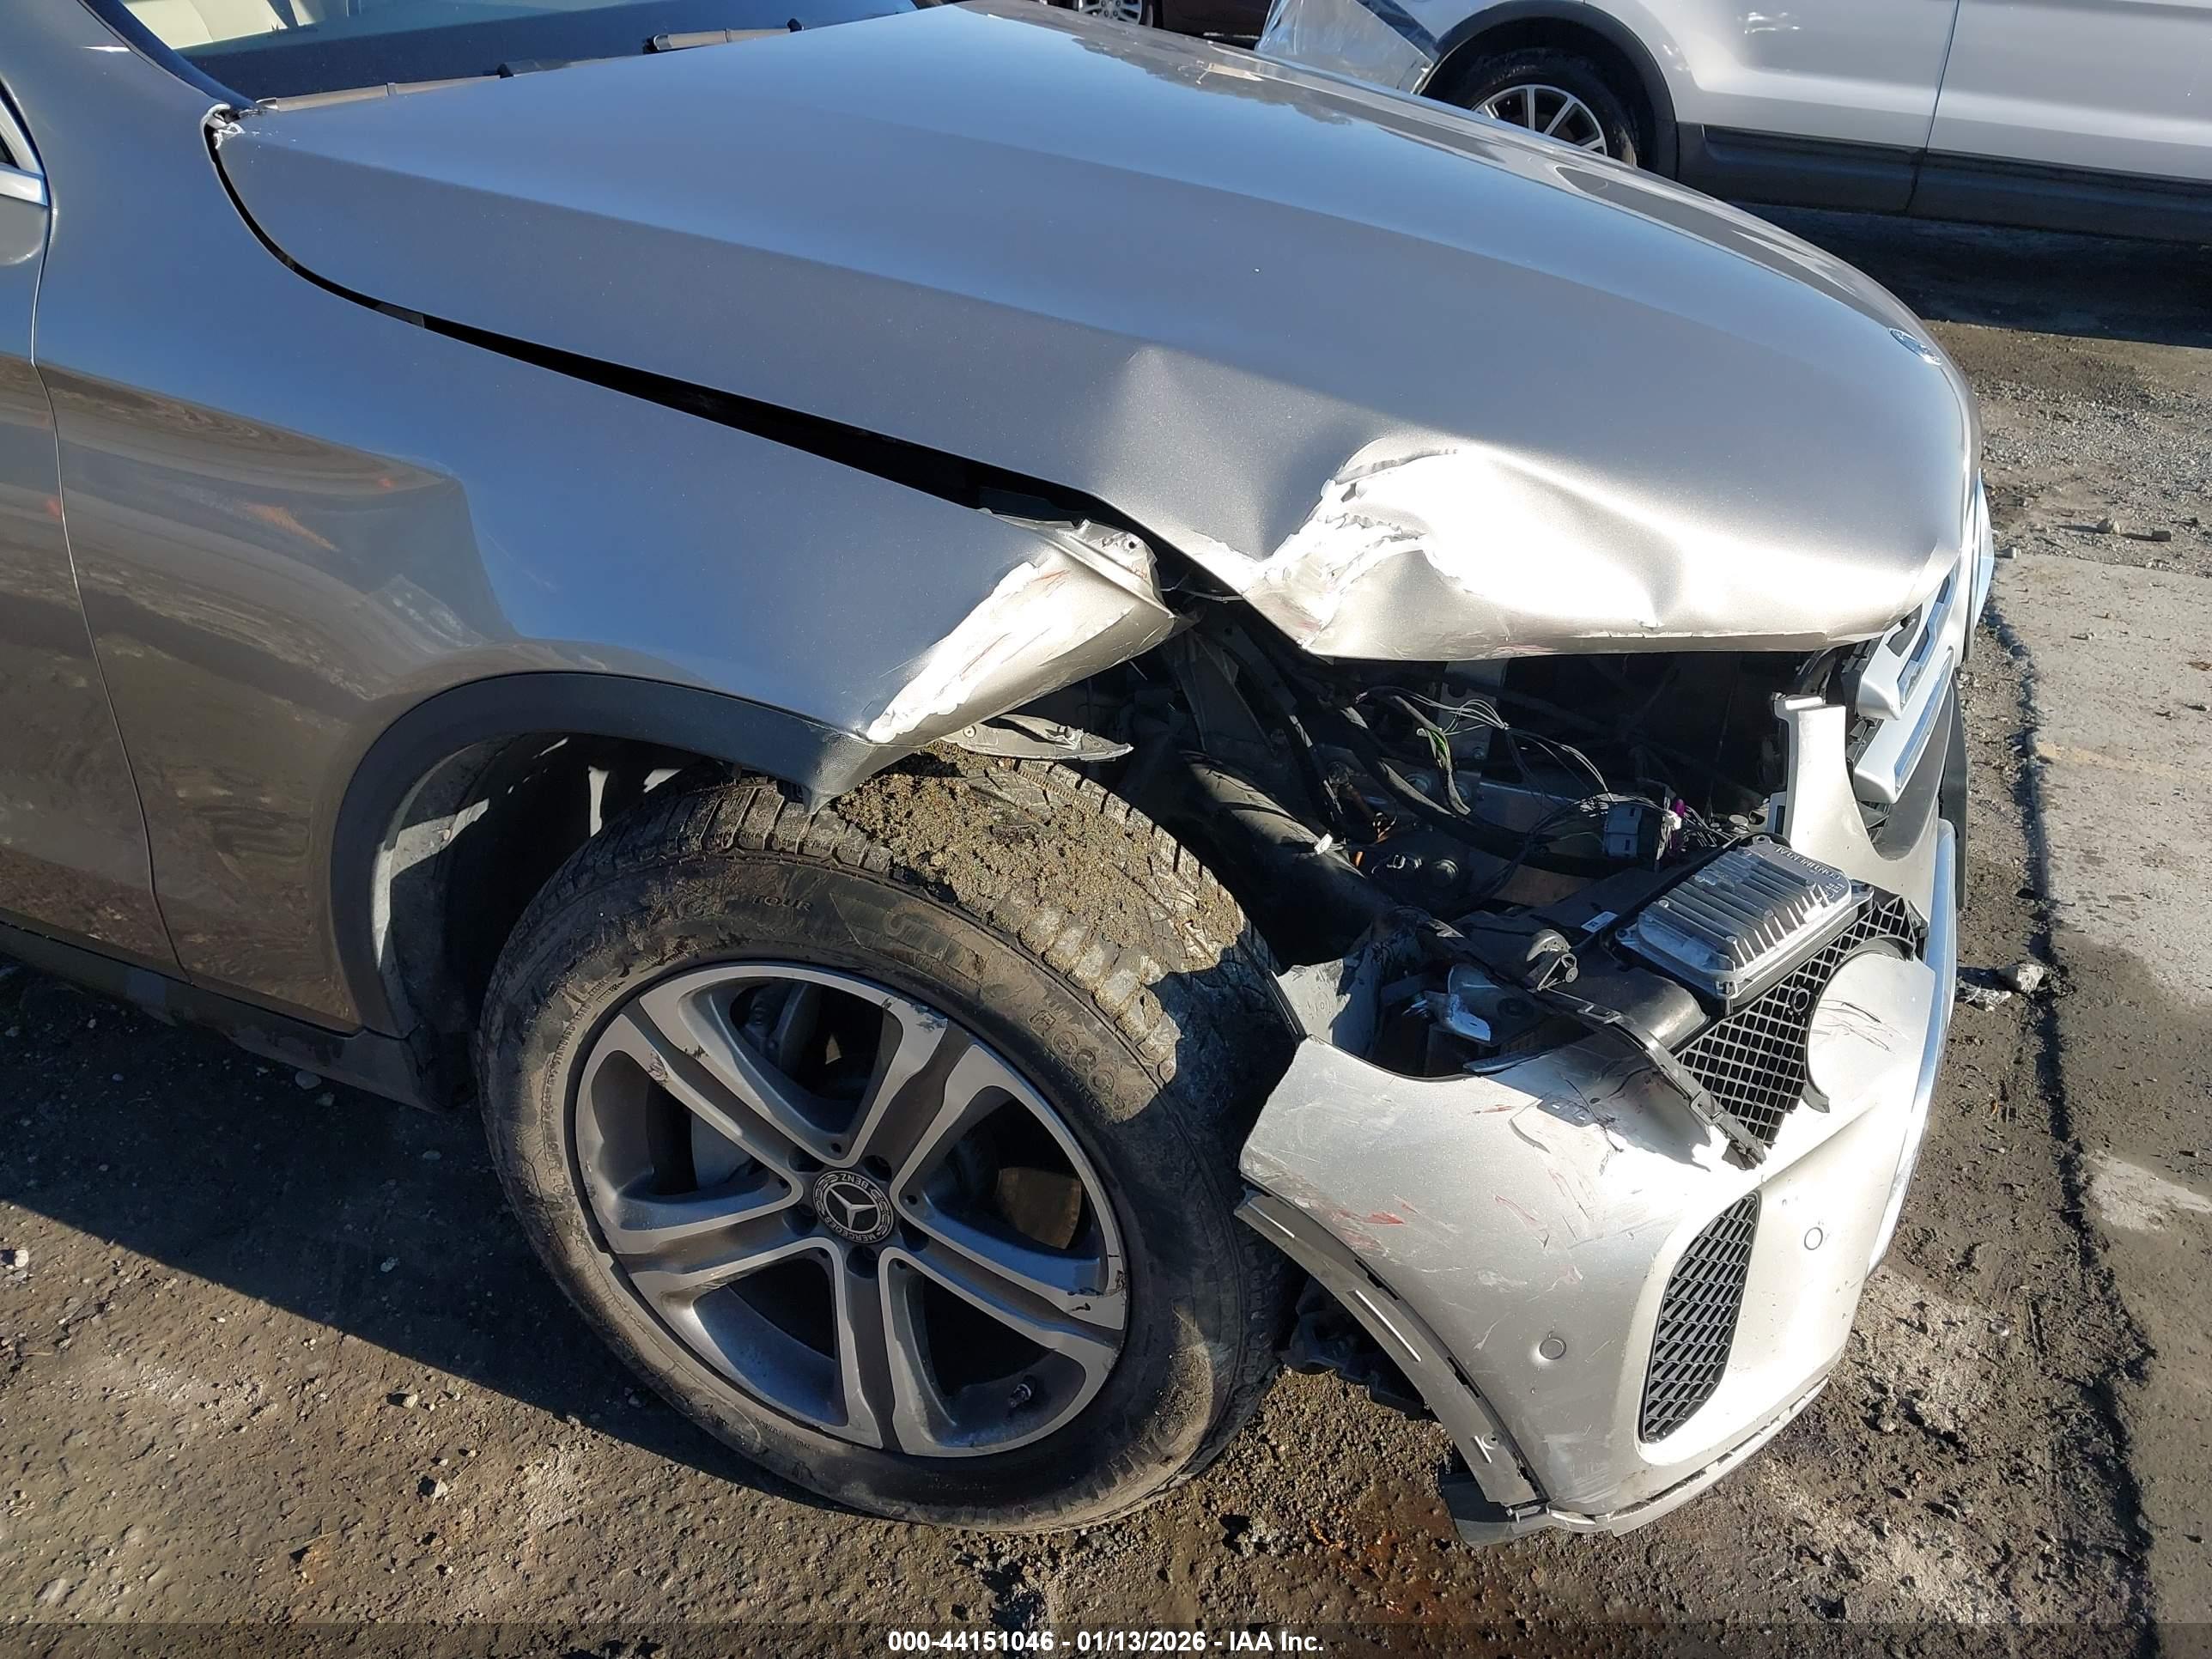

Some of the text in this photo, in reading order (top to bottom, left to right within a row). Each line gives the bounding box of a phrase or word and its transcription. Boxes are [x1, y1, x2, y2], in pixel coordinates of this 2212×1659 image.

[1774, 846, 1841, 880] CONTINENTAL
[840, 1173, 869, 1189] BENZ
[824, 1216, 877, 1242] MERCEDES
